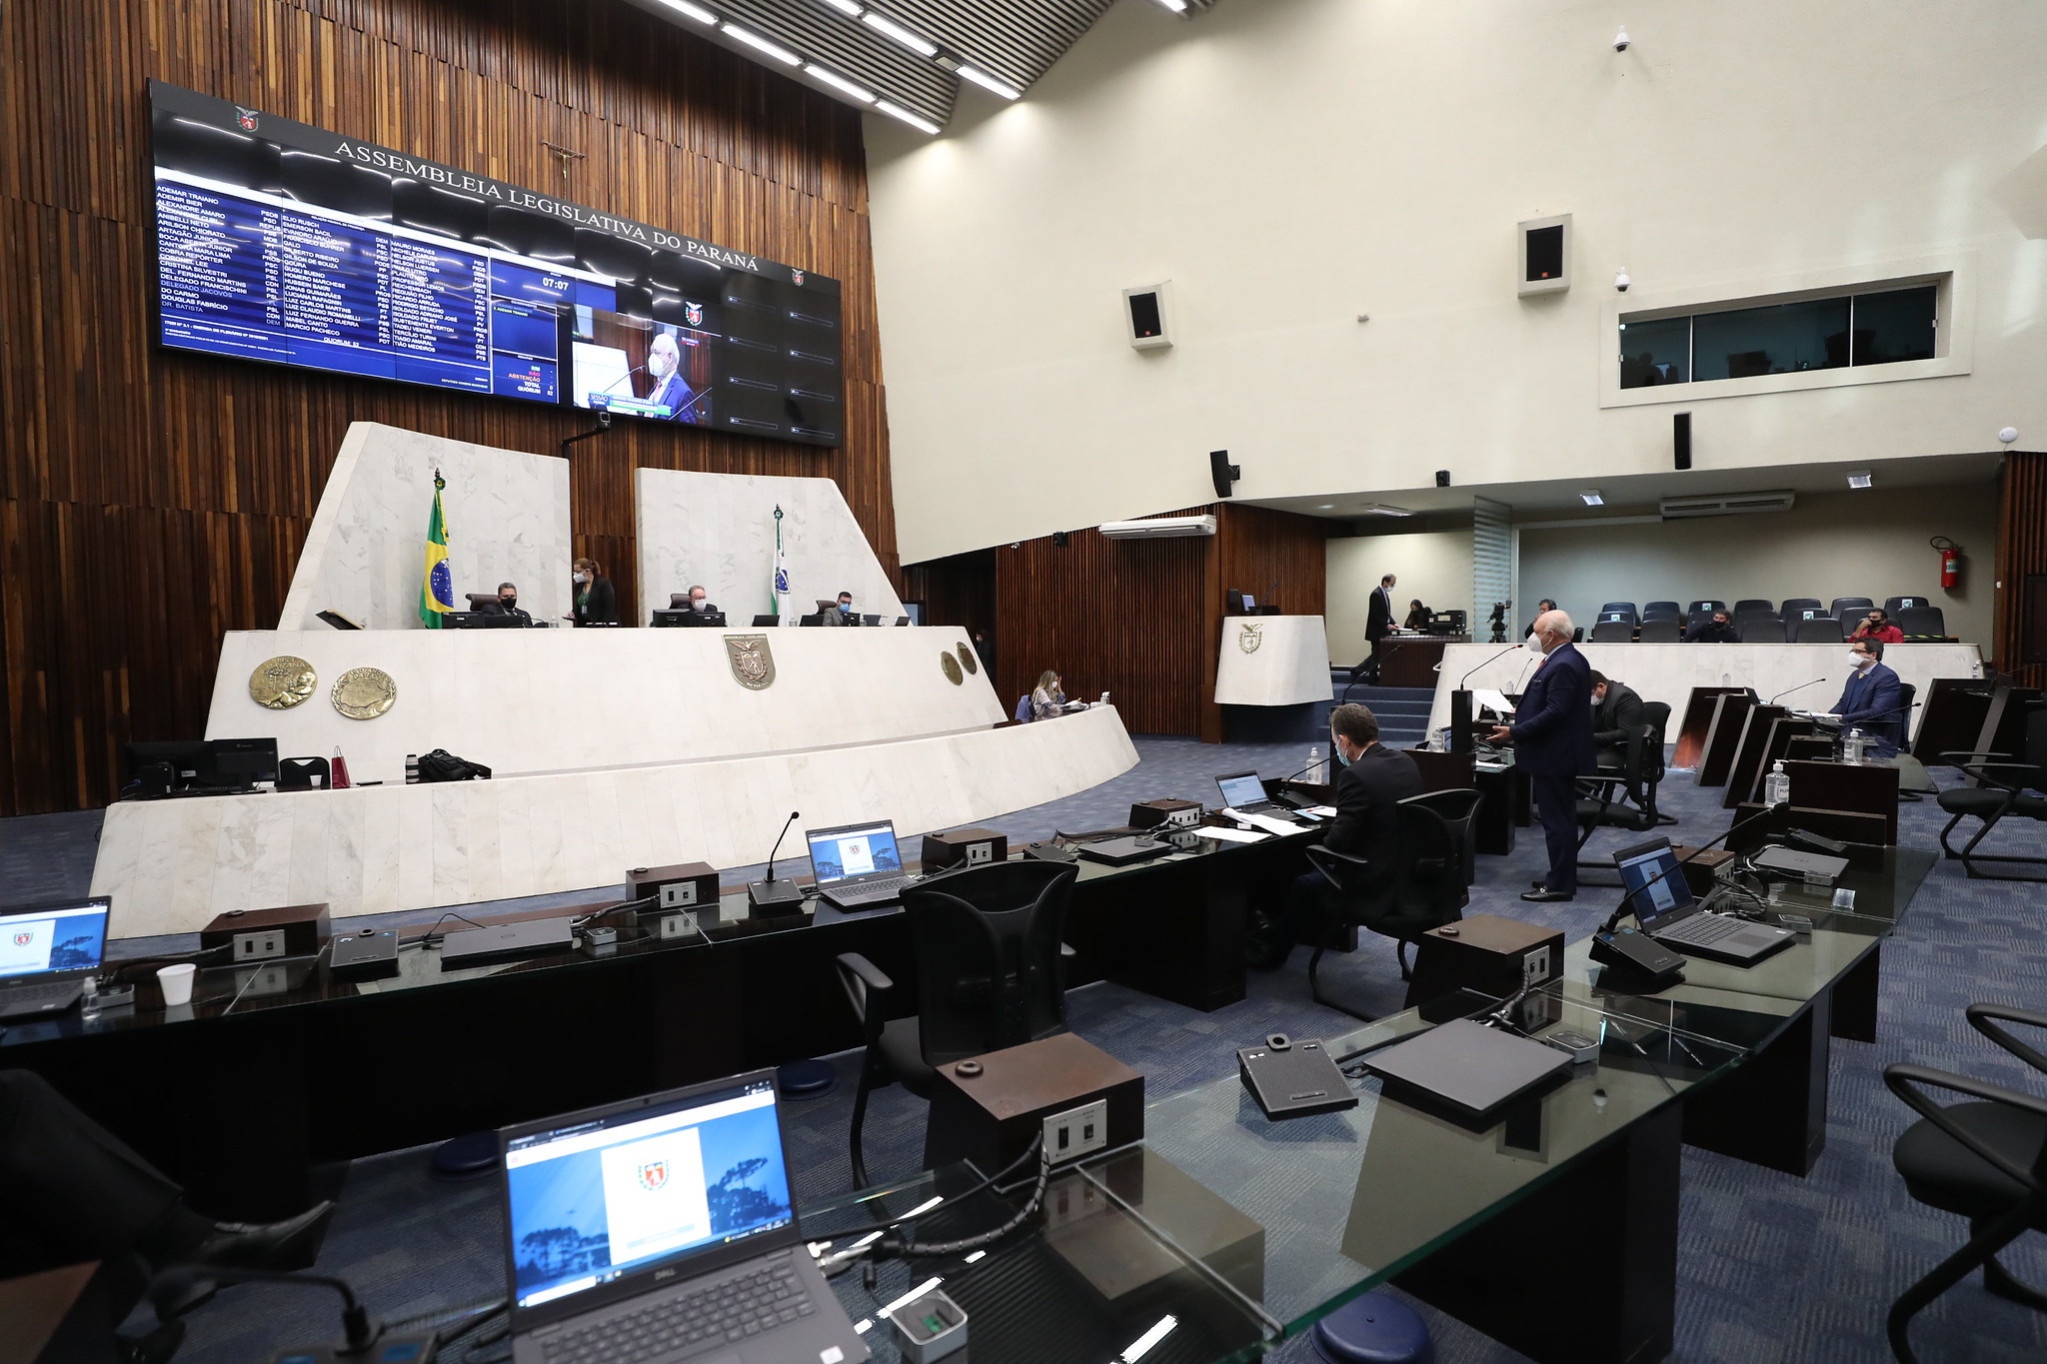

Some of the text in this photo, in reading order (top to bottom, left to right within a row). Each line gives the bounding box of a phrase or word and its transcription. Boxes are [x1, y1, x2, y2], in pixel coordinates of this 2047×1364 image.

[157, 186, 187, 198] ADEMAR
[157, 192, 185, 204] ADEMIR
[186, 199, 202, 208] BIER
[157, 199, 199, 214] ALEXANDRE
[202, 209, 226, 220] AMARO
[335, 142, 759, 272] ASSEMBLEIA LEGISLATIVA DO PARANÁ
[158, 213, 188, 225] ANIBELLI
[190, 220, 209, 229] NETO
[158, 220, 189, 231] ARILSON
[191, 227, 226, 239] CHIORATO
[159, 233, 179, 242] BOCA
[159, 247, 184, 257] COBRA
[195, 248, 213, 256] MARA
[215, 252, 231, 260] LIMA
[160, 260, 192, 272] CRISTINA
[194, 267, 227, 278] SILVESTRI
[160, 267, 176, 275] DEL.
[178, 271, 216, 283] FERNANDO
[217, 278, 246, 288] MARTINS
[285, 272, 312, 282] HOMERO
[161, 274, 199, 286] DELEGADO
[200, 282, 247, 295] FRANCISCHINI
[161, 281, 232, 299] DELEGADO JACOVÓS
[542, 278, 569, 290] 07:07
[174, 290, 199, 299] CARMO
[162, 294, 195, 305] DOUGLAS
[197, 300, 228, 311] FABRÍCIO
[176, 303, 203, 313] BATISTA
[300, 300, 324, 309] CARLOS
[300, 313, 333, 323] FERNANDO
[308, 320, 328, 328] CANTO
[508, 373, 541, 383] ABSTENÇÃO
